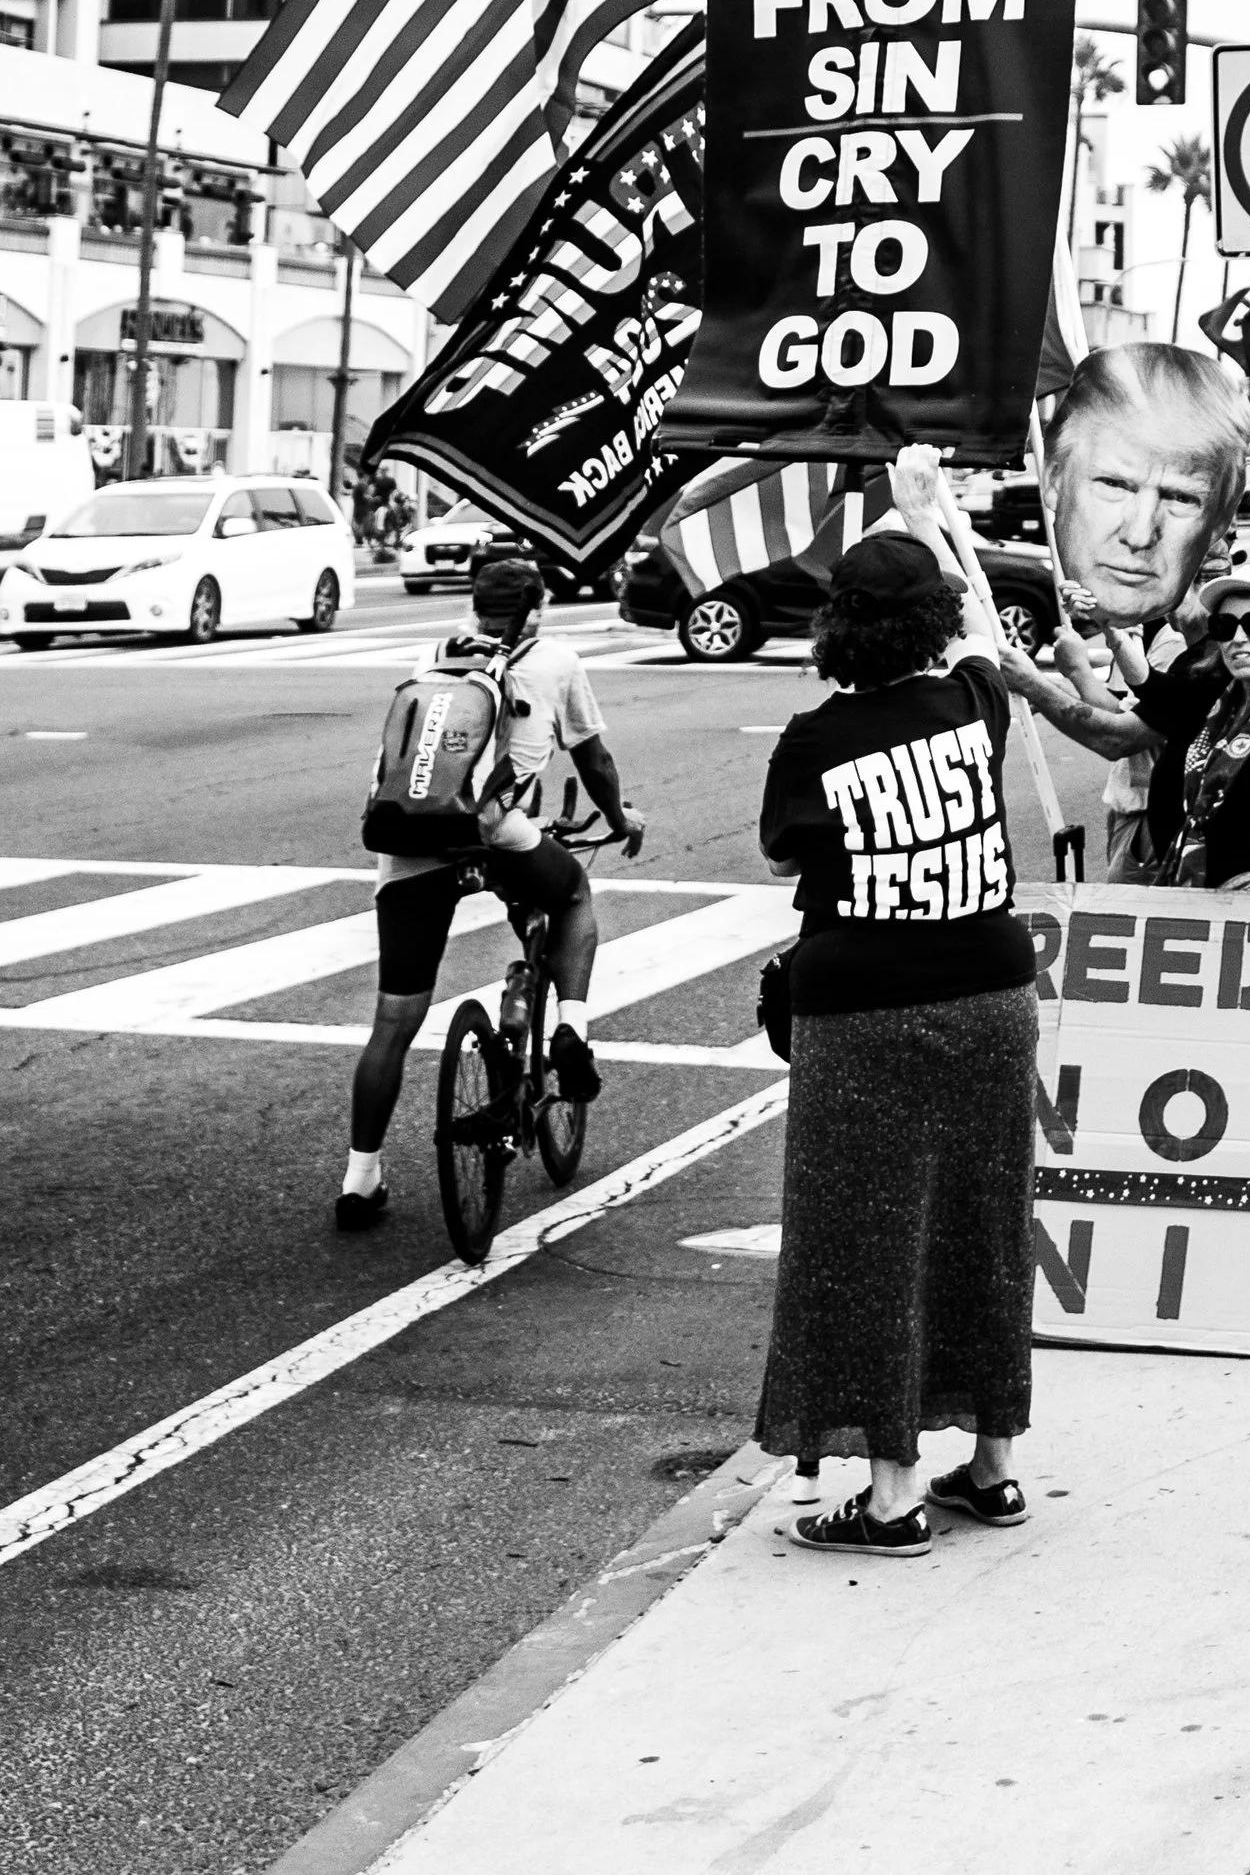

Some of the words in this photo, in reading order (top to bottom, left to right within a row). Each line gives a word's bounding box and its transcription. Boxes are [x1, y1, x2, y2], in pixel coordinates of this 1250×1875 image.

[804, 40, 962, 121] SIN
[779, 129, 975, 210] CRY
[803, 220, 928, 297] TO
[758, 310, 960, 388] GOD
[821, 719, 998, 851] TRUST
[838, 825, 1008, 922] JESUS
